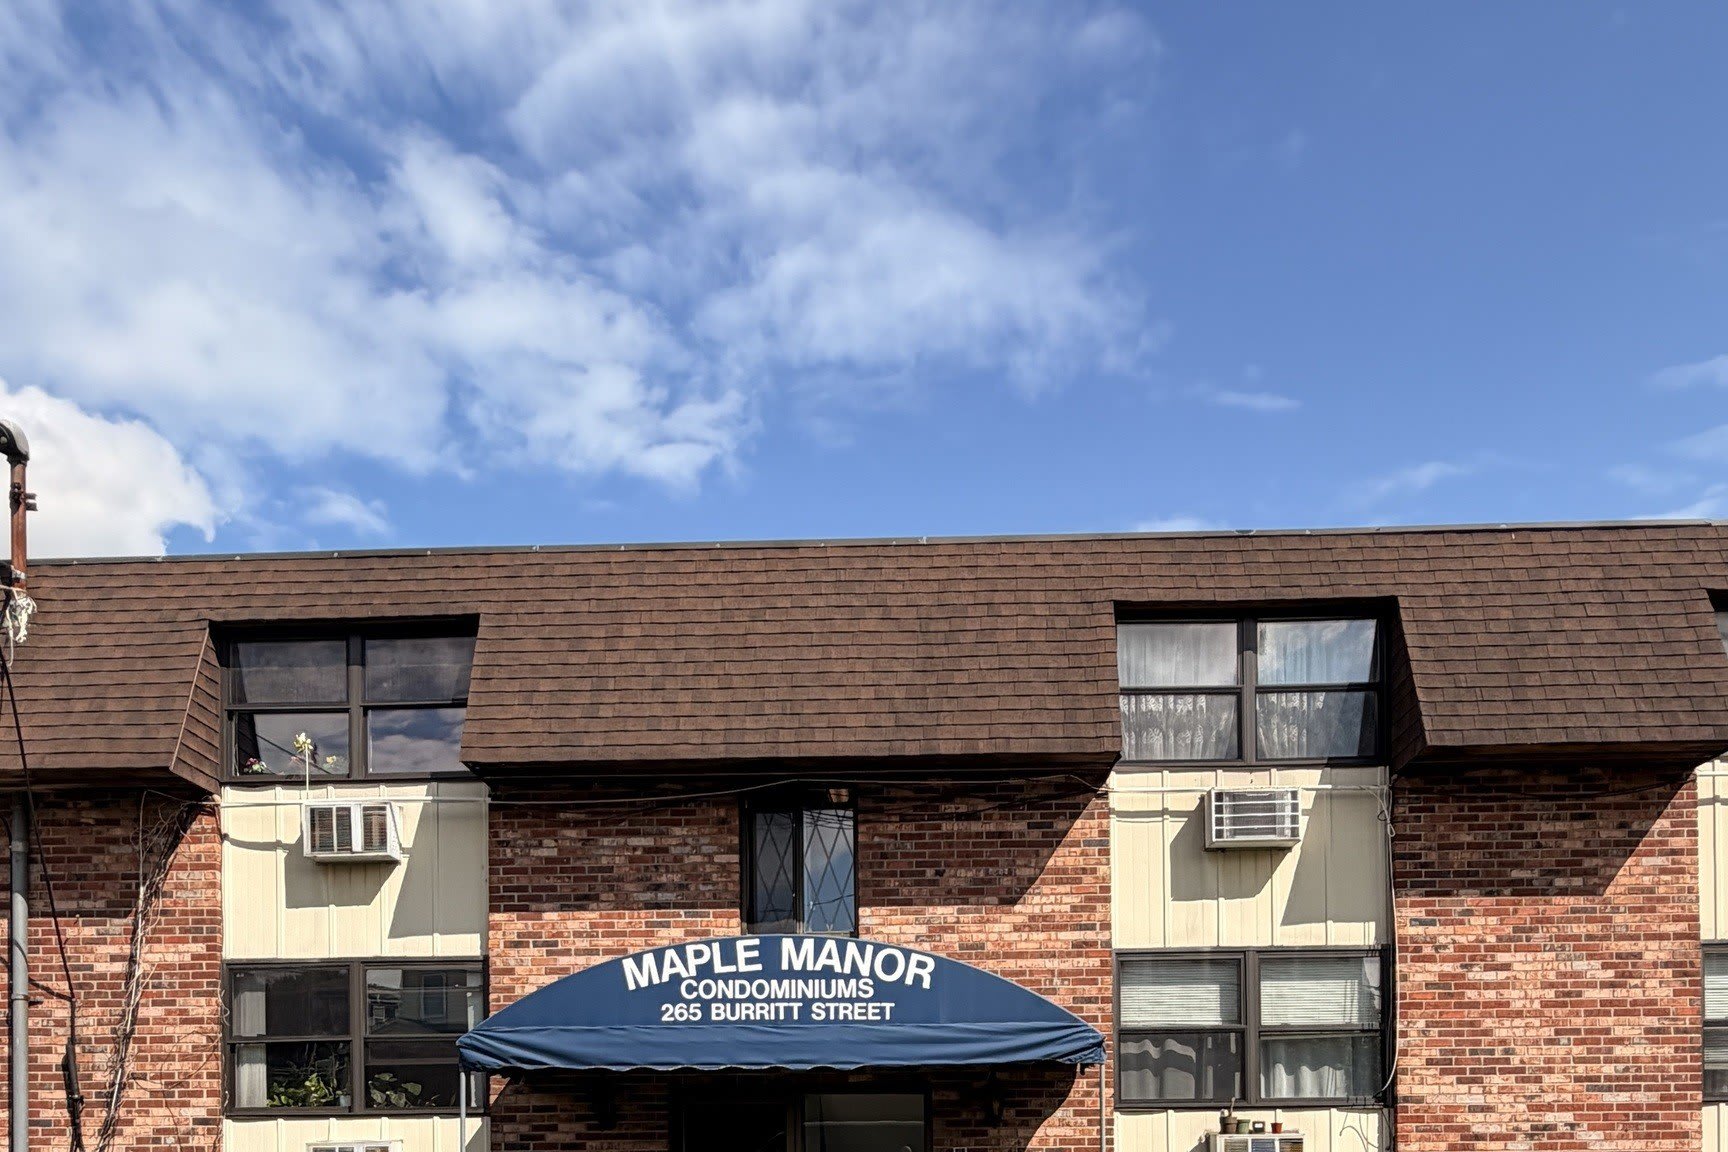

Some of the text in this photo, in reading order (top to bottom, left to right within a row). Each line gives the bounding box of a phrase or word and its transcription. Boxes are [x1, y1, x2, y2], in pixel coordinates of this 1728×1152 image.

[621, 937, 936, 991] MAPLE MANOR
[680, 978, 874, 1000] CONDOMINIUMS
[661, 1002, 895, 1022] 265 BURRITT STREET
